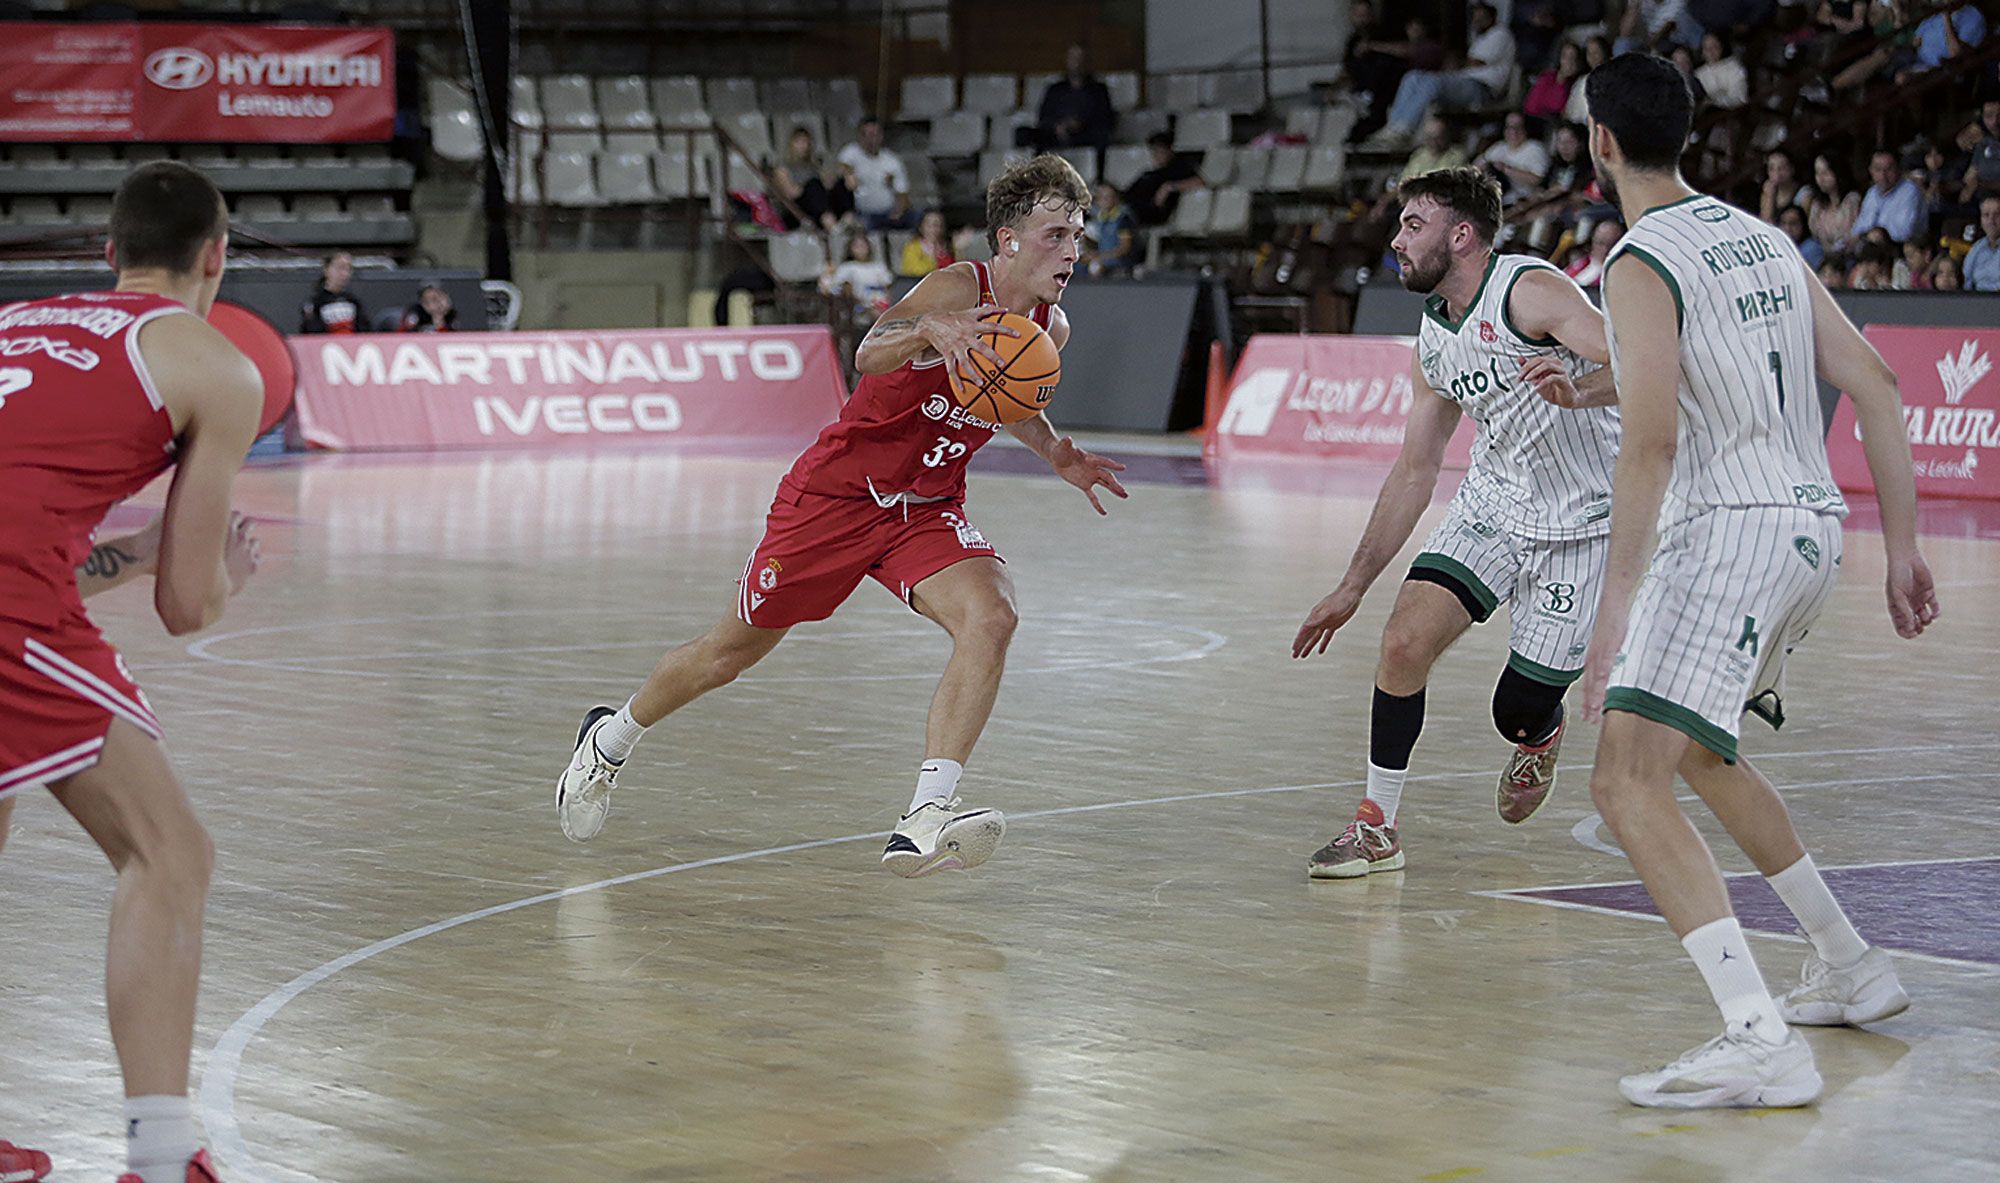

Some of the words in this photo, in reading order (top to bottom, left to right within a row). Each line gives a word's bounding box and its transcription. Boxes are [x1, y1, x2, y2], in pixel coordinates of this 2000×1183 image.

[217, 53, 382, 87] HYUNDAI
[217, 92, 335, 117] Lemauto
[321, 340, 804, 386] MARTINAUTO
[472, 393, 683, 436] IVECO
[922, 436, 967, 468] 32
